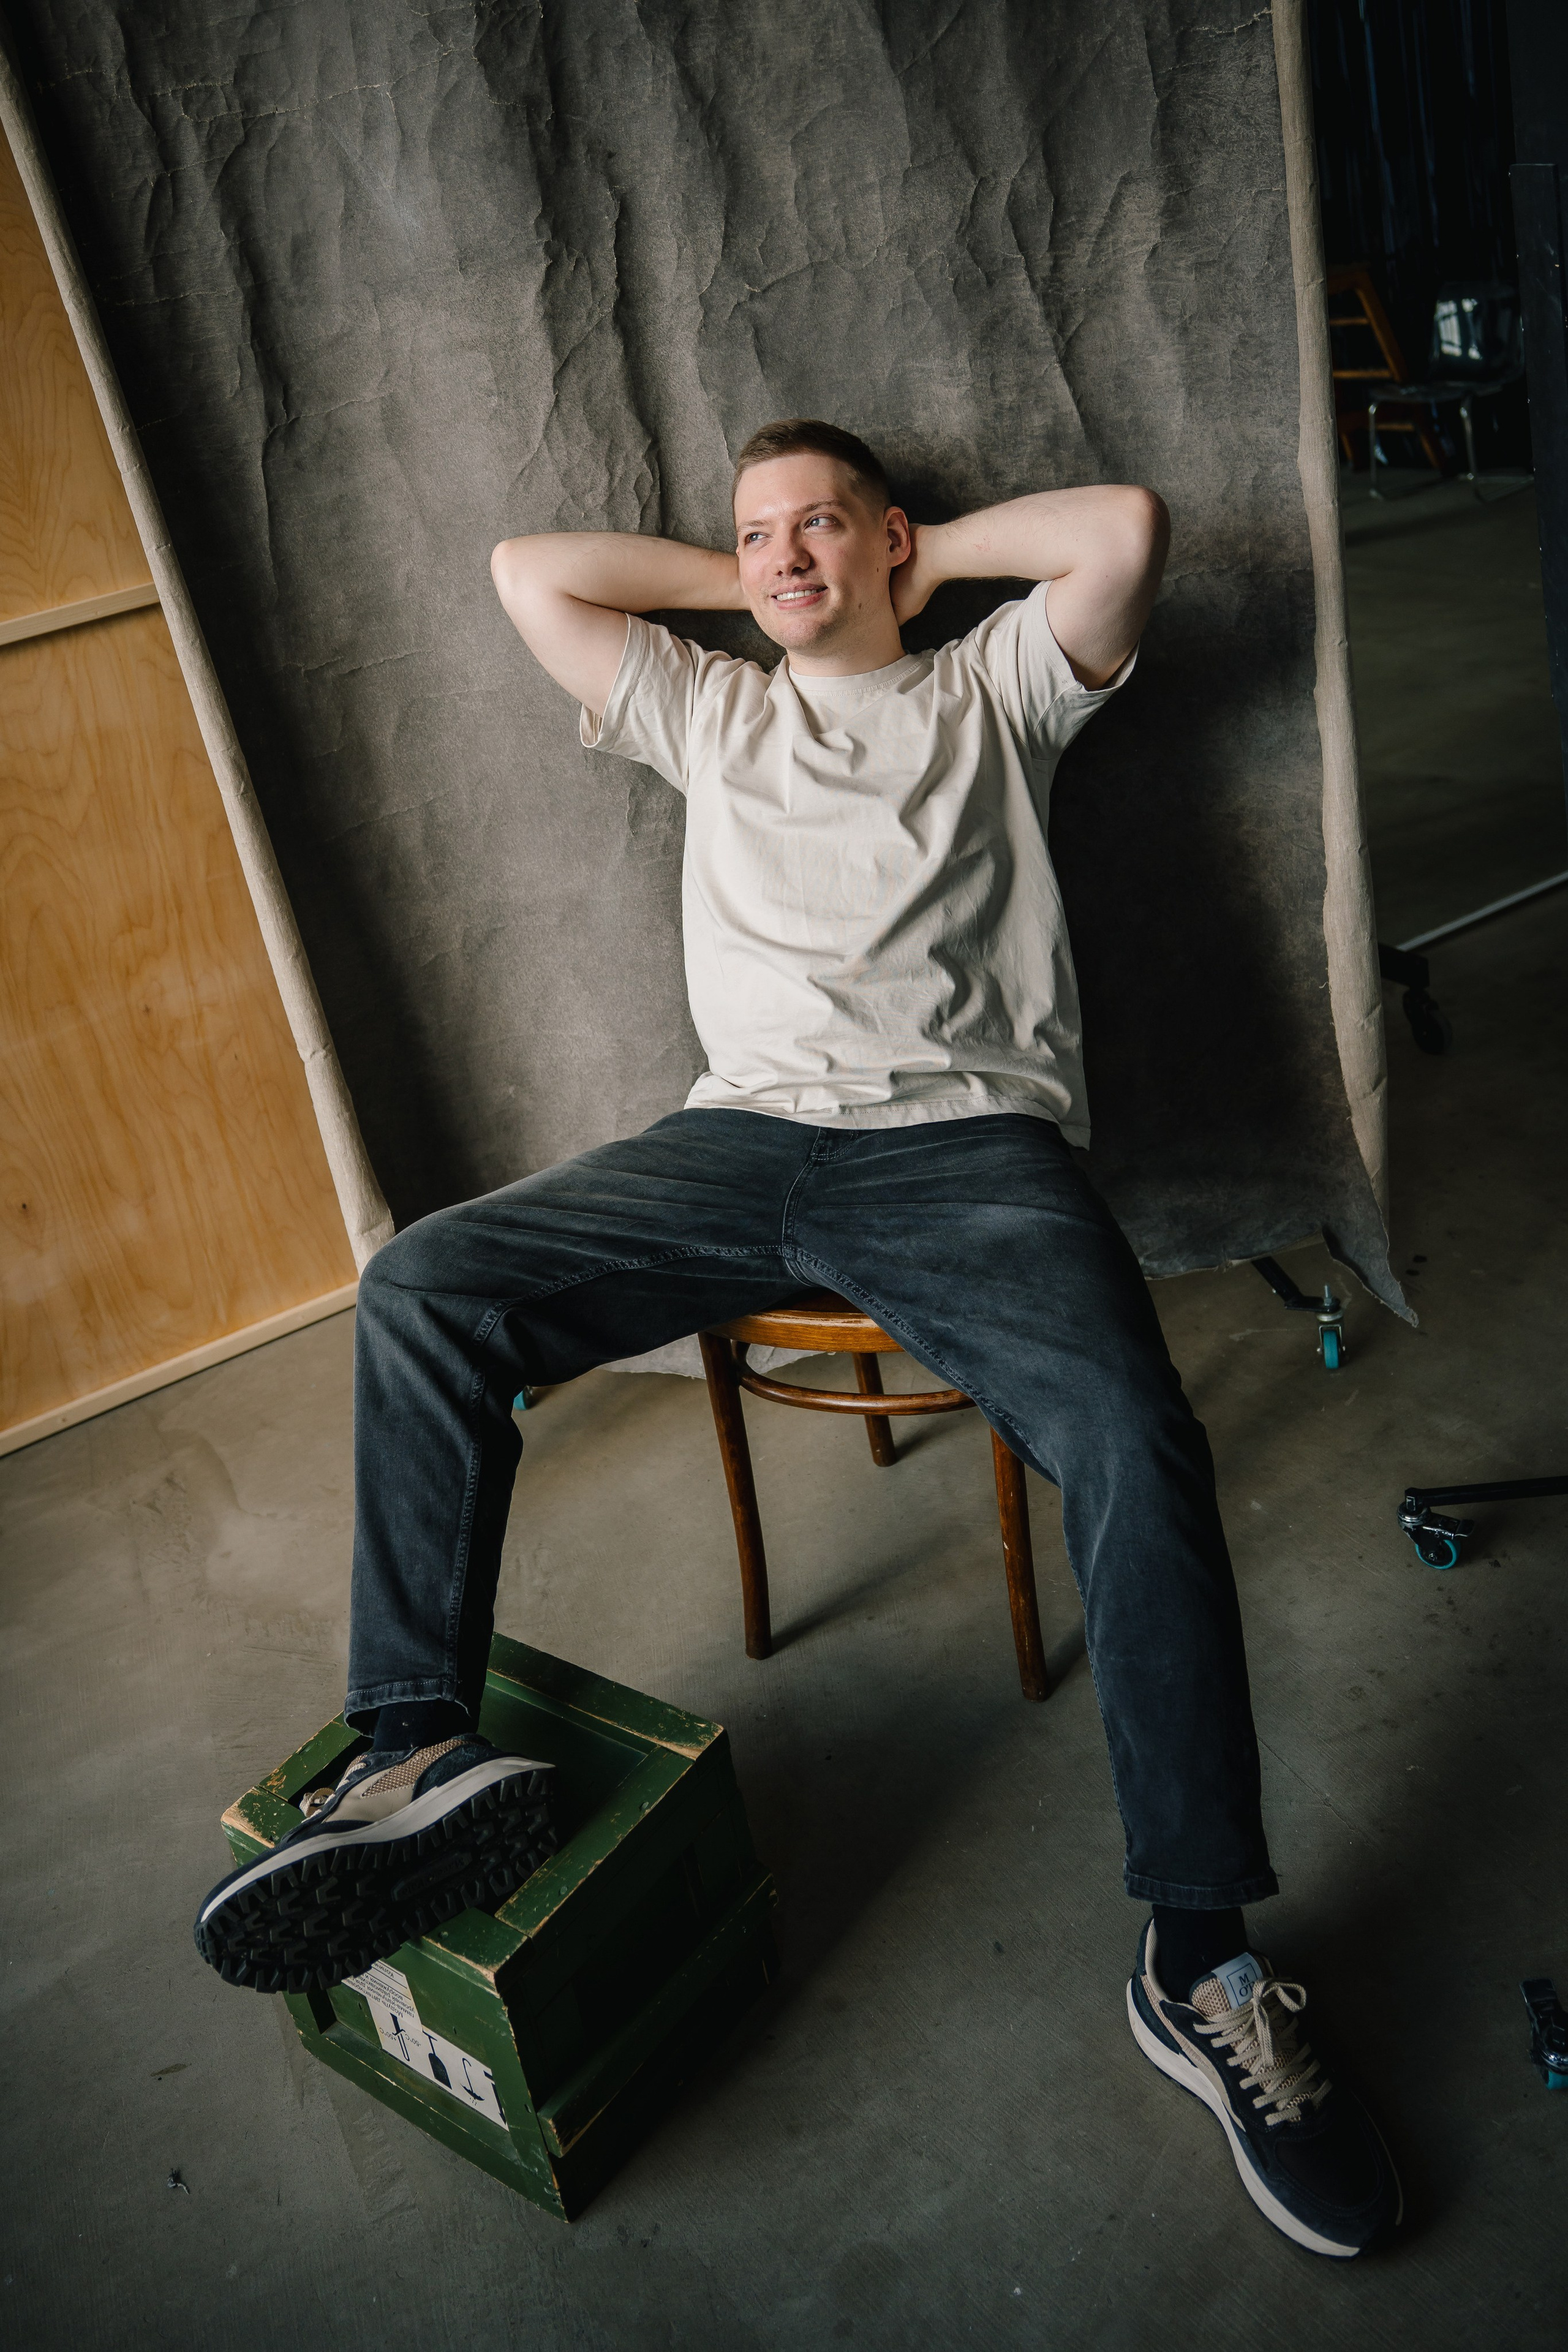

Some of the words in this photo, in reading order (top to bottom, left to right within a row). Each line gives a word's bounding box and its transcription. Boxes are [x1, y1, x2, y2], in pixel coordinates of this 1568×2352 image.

[374, 1963, 394, 1978] Колич
[1238, 1973, 1250, 1986] M
[382, 2000, 403, 2018] Модуль
[391, 1995, 414, 2013] уровней
